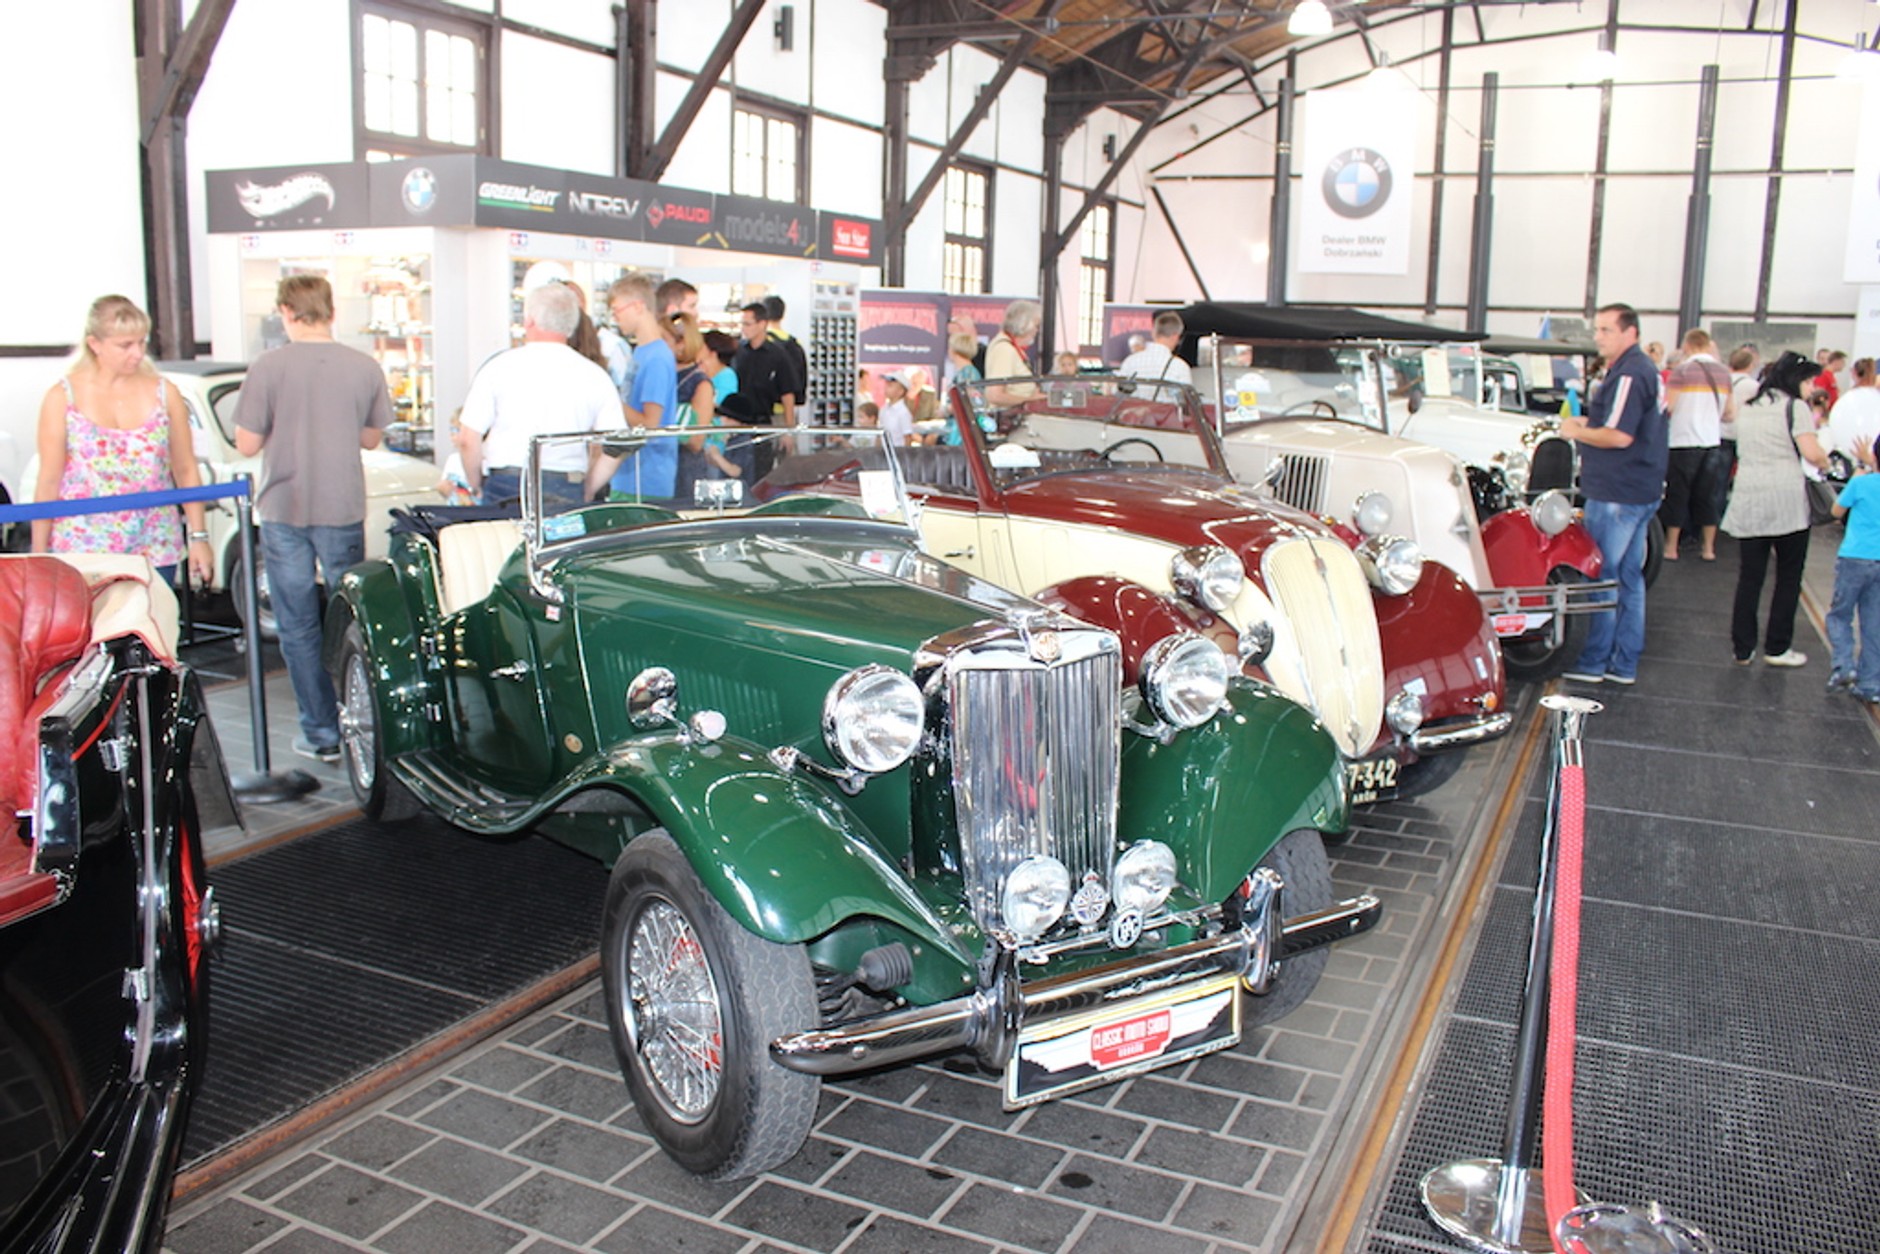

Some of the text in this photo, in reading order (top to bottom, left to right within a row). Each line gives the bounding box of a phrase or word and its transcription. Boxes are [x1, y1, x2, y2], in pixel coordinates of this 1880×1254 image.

[569, 191, 640, 219] NOREV
[664, 204, 710, 224] PAUDI
[725, 212, 808, 248] models4u
[1322, 235, 1387, 245] Dealer BMW
